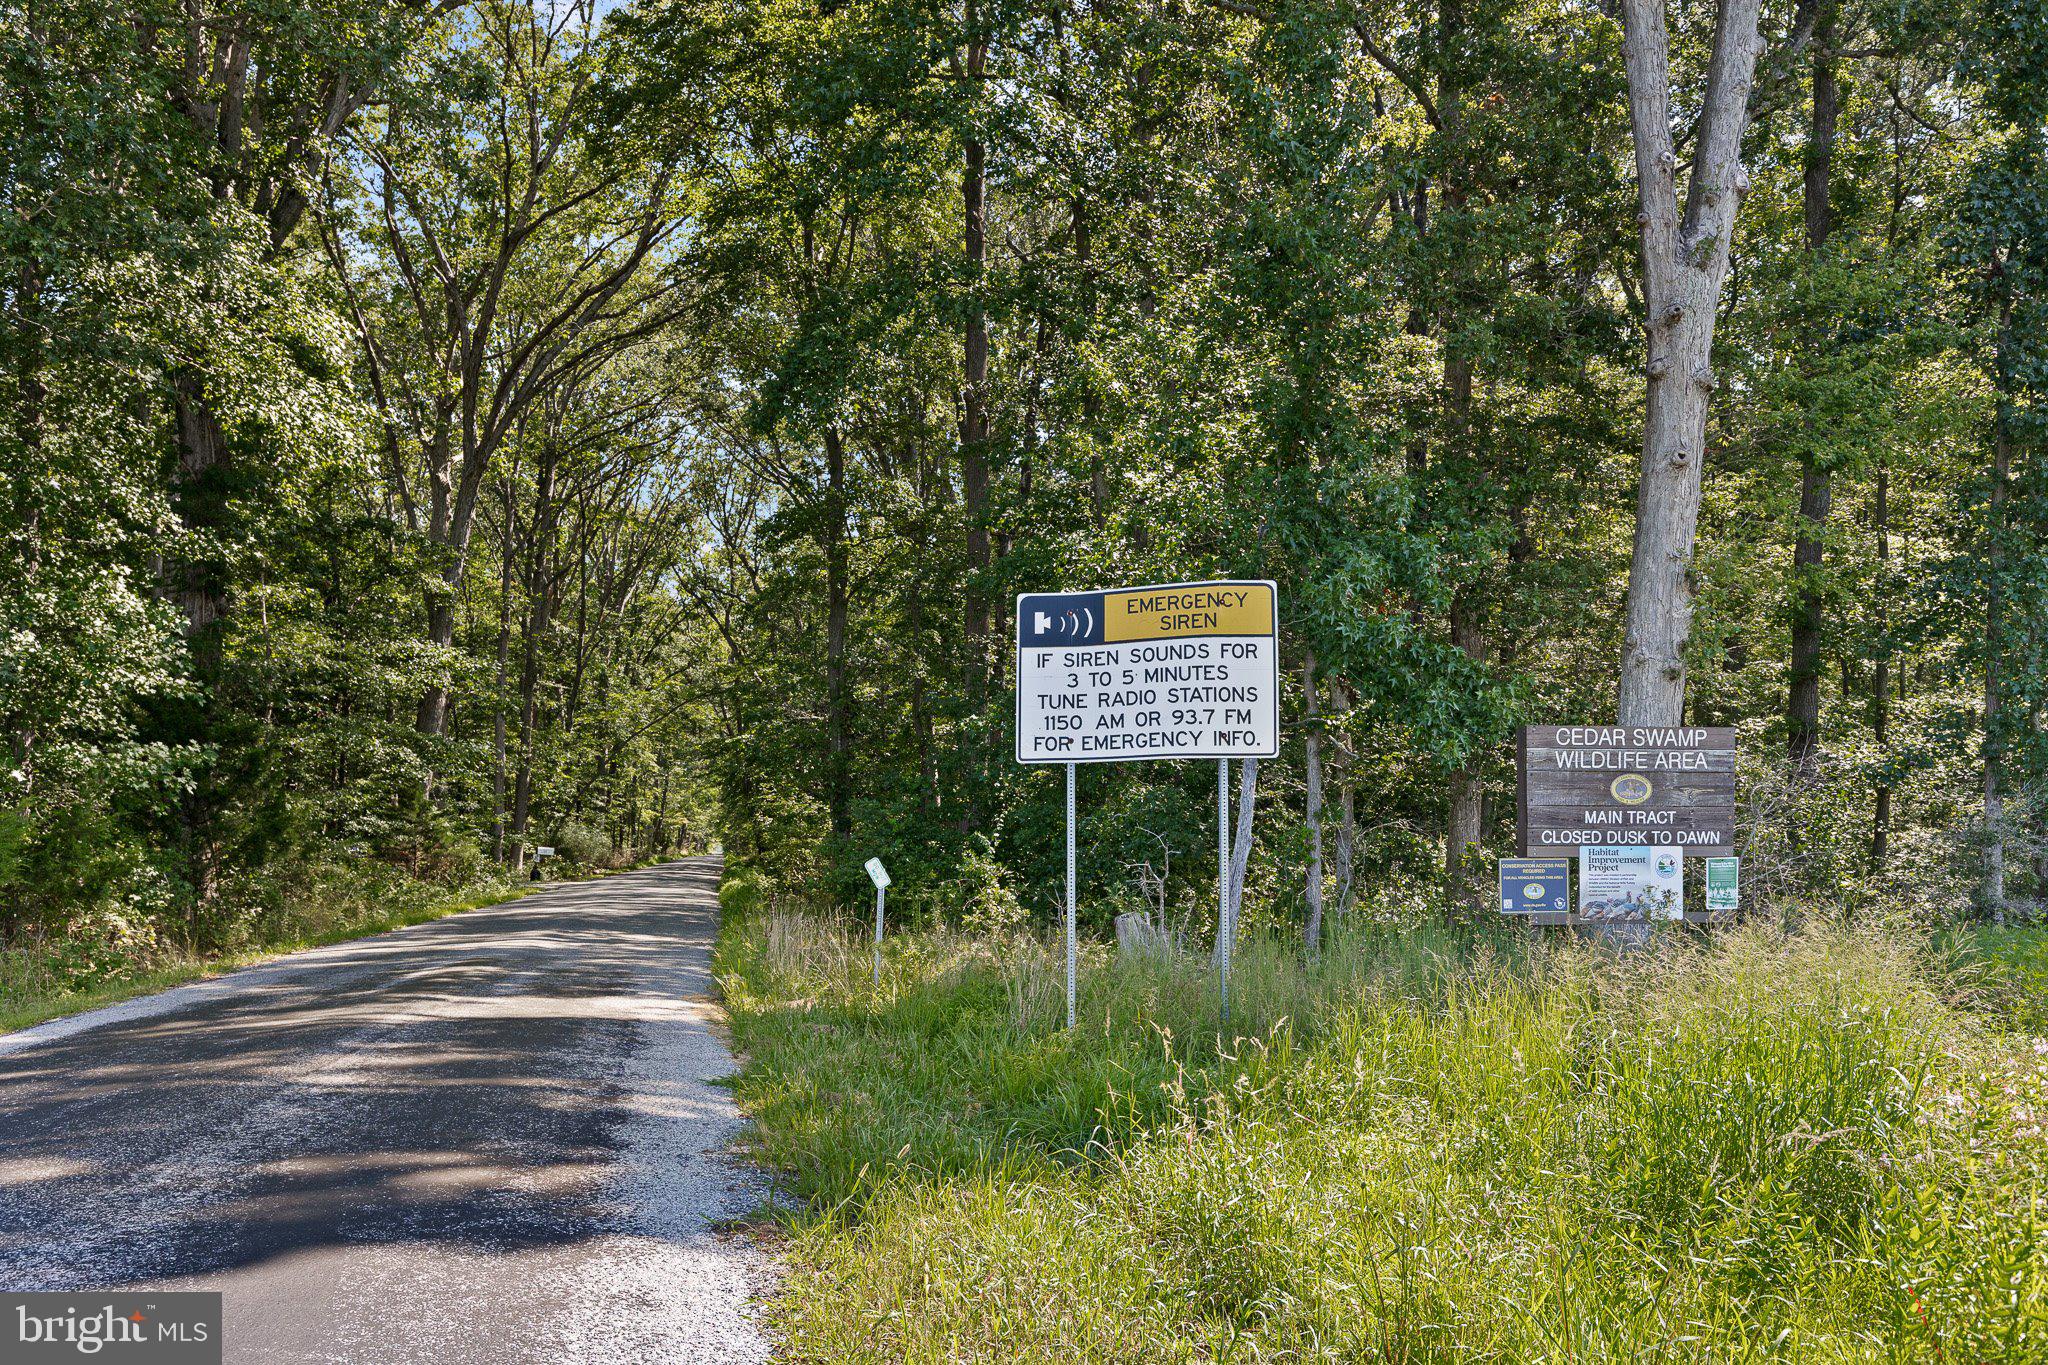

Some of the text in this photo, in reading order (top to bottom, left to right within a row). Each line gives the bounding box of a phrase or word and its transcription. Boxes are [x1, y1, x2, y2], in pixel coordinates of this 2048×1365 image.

[1127, 592, 1248, 614] EMERGENCY
[1160, 613, 1216, 630] SIREN
[1038, 643, 1258, 668] IF SIREN SOUNDS FOR
[1067, 665, 1228, 687] 3 TO 5 MINUTES
[1038, 687, 1258, 709] TUNE RADIO STATIONS
[1045, 709, 1251, 730] 1150 AM OR 93.7 FM
[1034, 730, 1260, 751] FOR EMERGENCY INFO.
[1556, 728, 1707, 746] CEDAR SWAMP
[1556, 751, 1707, 769] WILDLIFE AREA
[1585, 811, 1676, 824] MAIN TRACT
[1541, 830, 1719, 844] CLOSED DUSK TO DAWN
[1588, 864, 1619, 873] Project
